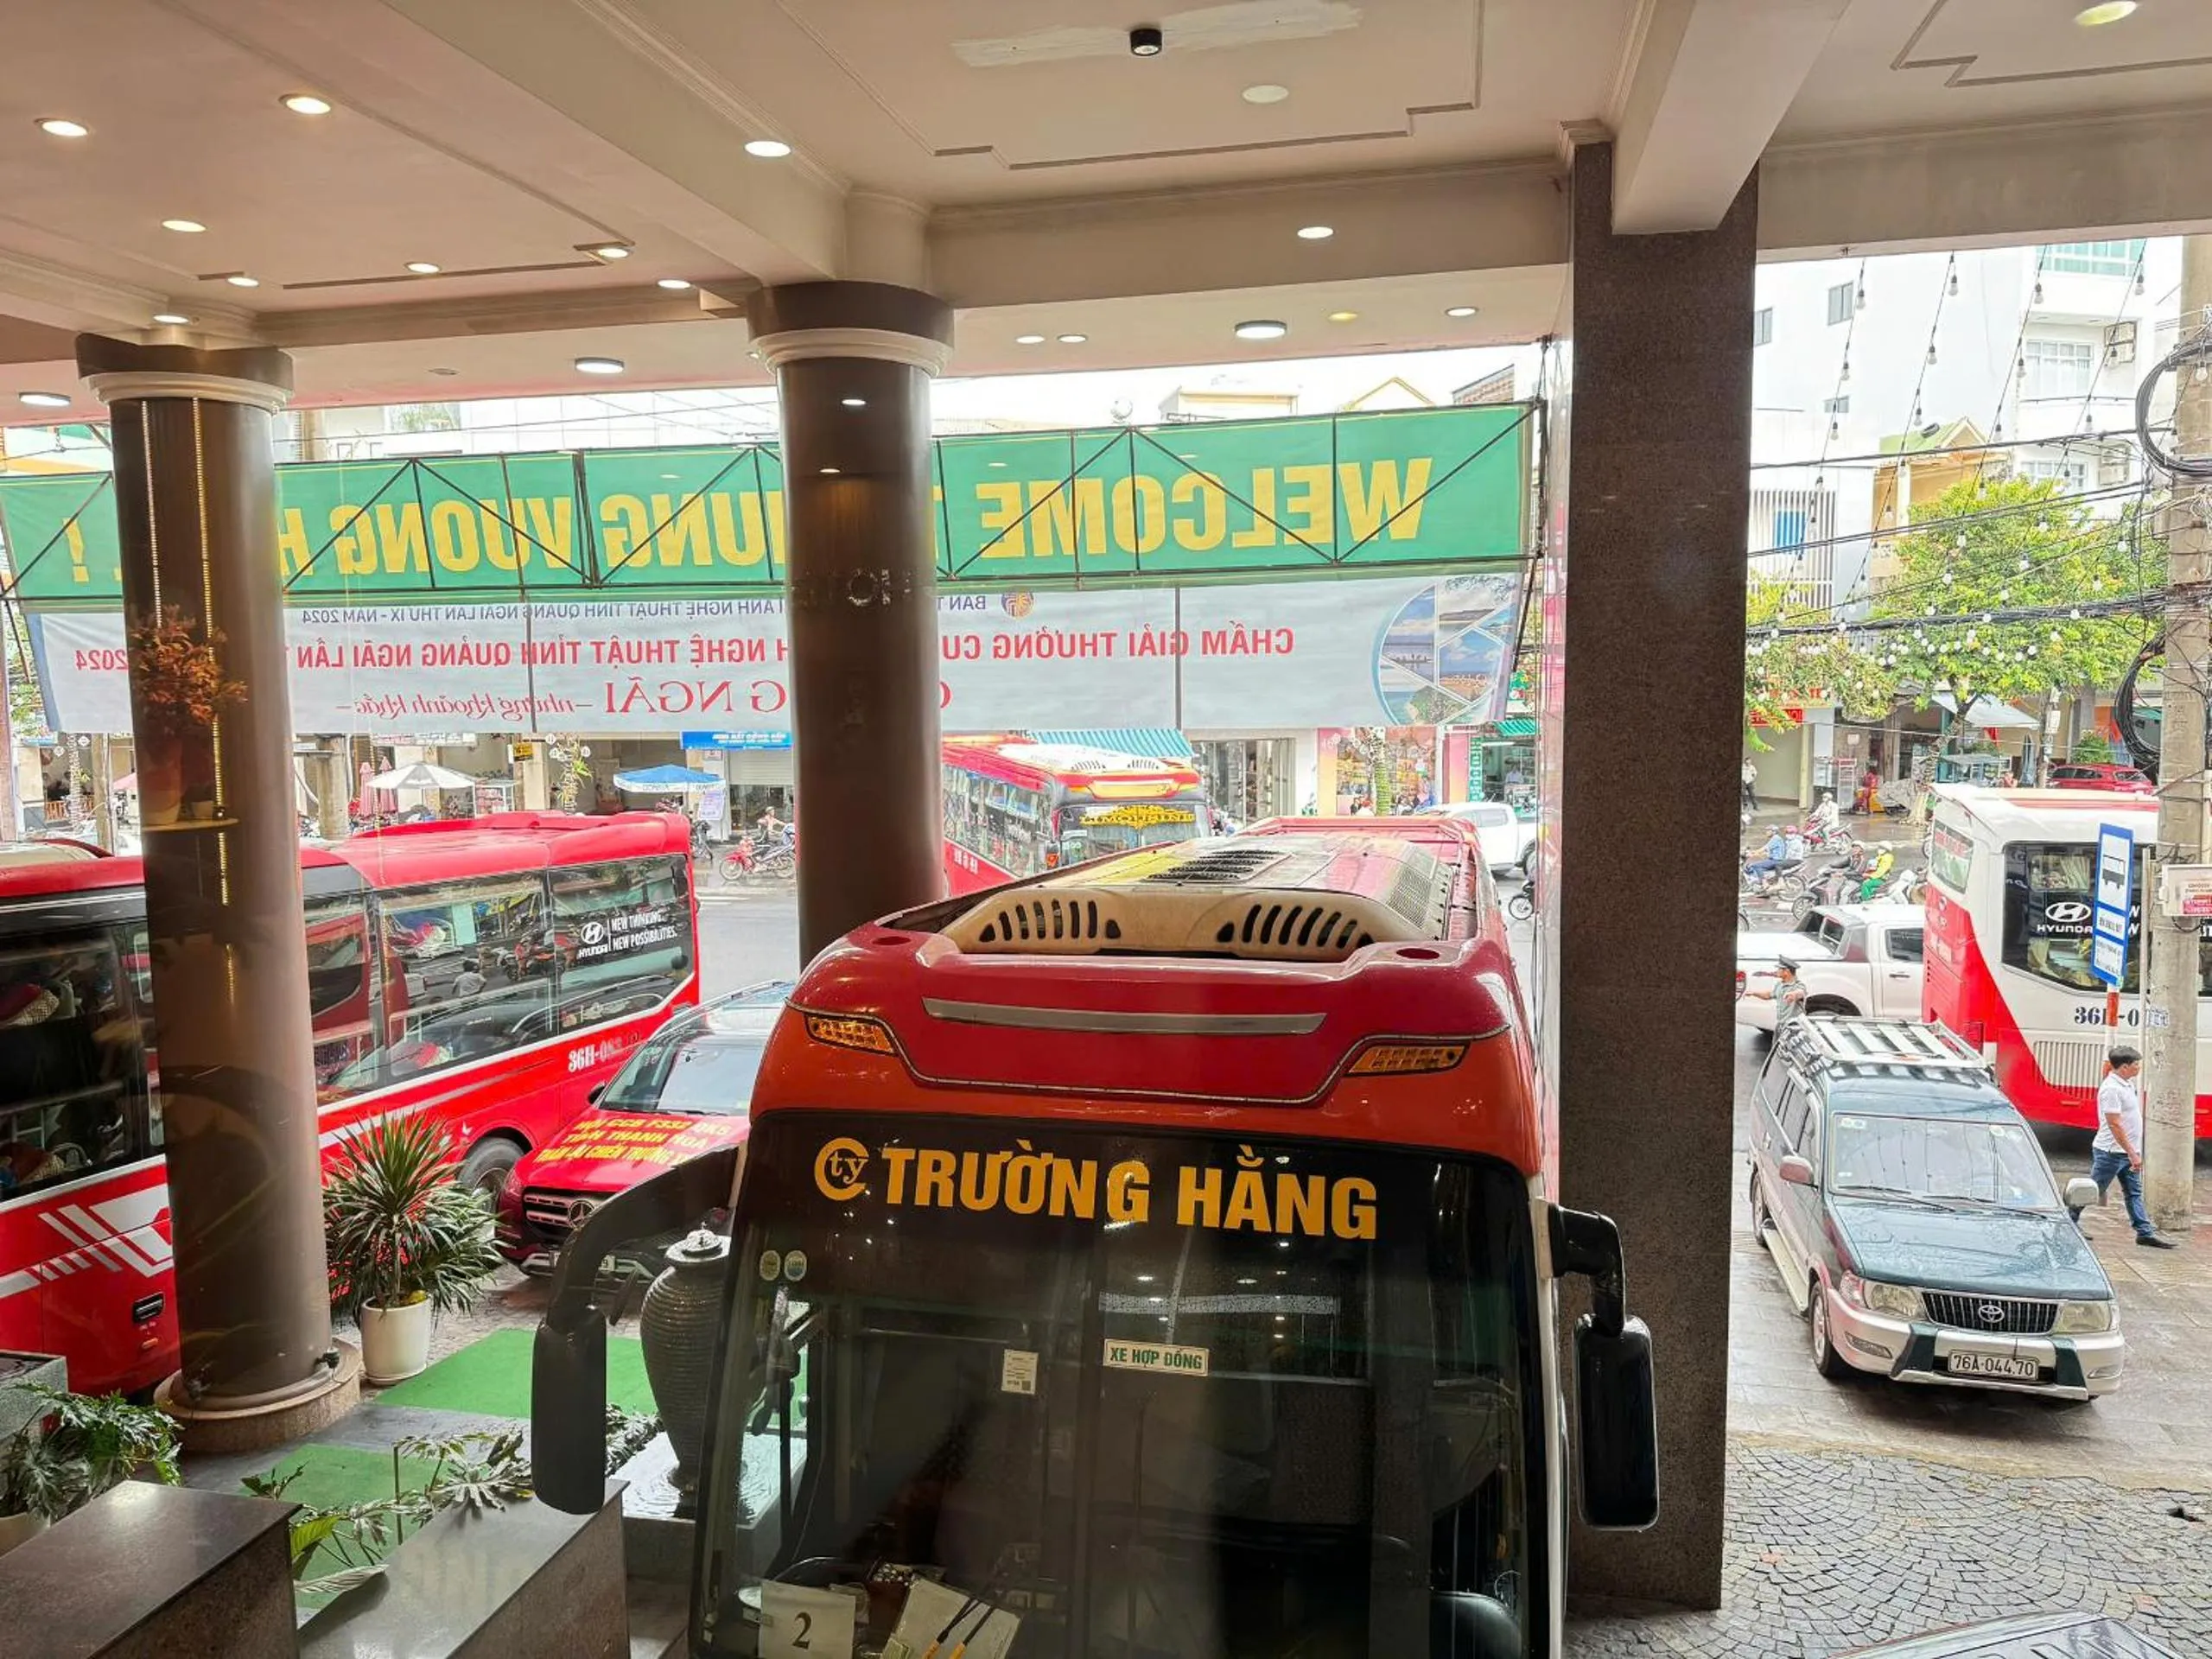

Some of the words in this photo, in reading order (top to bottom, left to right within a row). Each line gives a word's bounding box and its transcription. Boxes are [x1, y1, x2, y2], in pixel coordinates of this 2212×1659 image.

[2037, 924, 2093, 934] HYUNDA
[880, 1139, 1150, 1224] TRƯỜNG
[1178, 1144, 1377, 1240] HẰNG
[1109, 1347, 1128, 1362] XE
[1132, 1348, 1160, 1368] HỢP
[1164, 1348, 1203, 1370] ĐỒNG
[791, 1612, 812, 1650] 2
